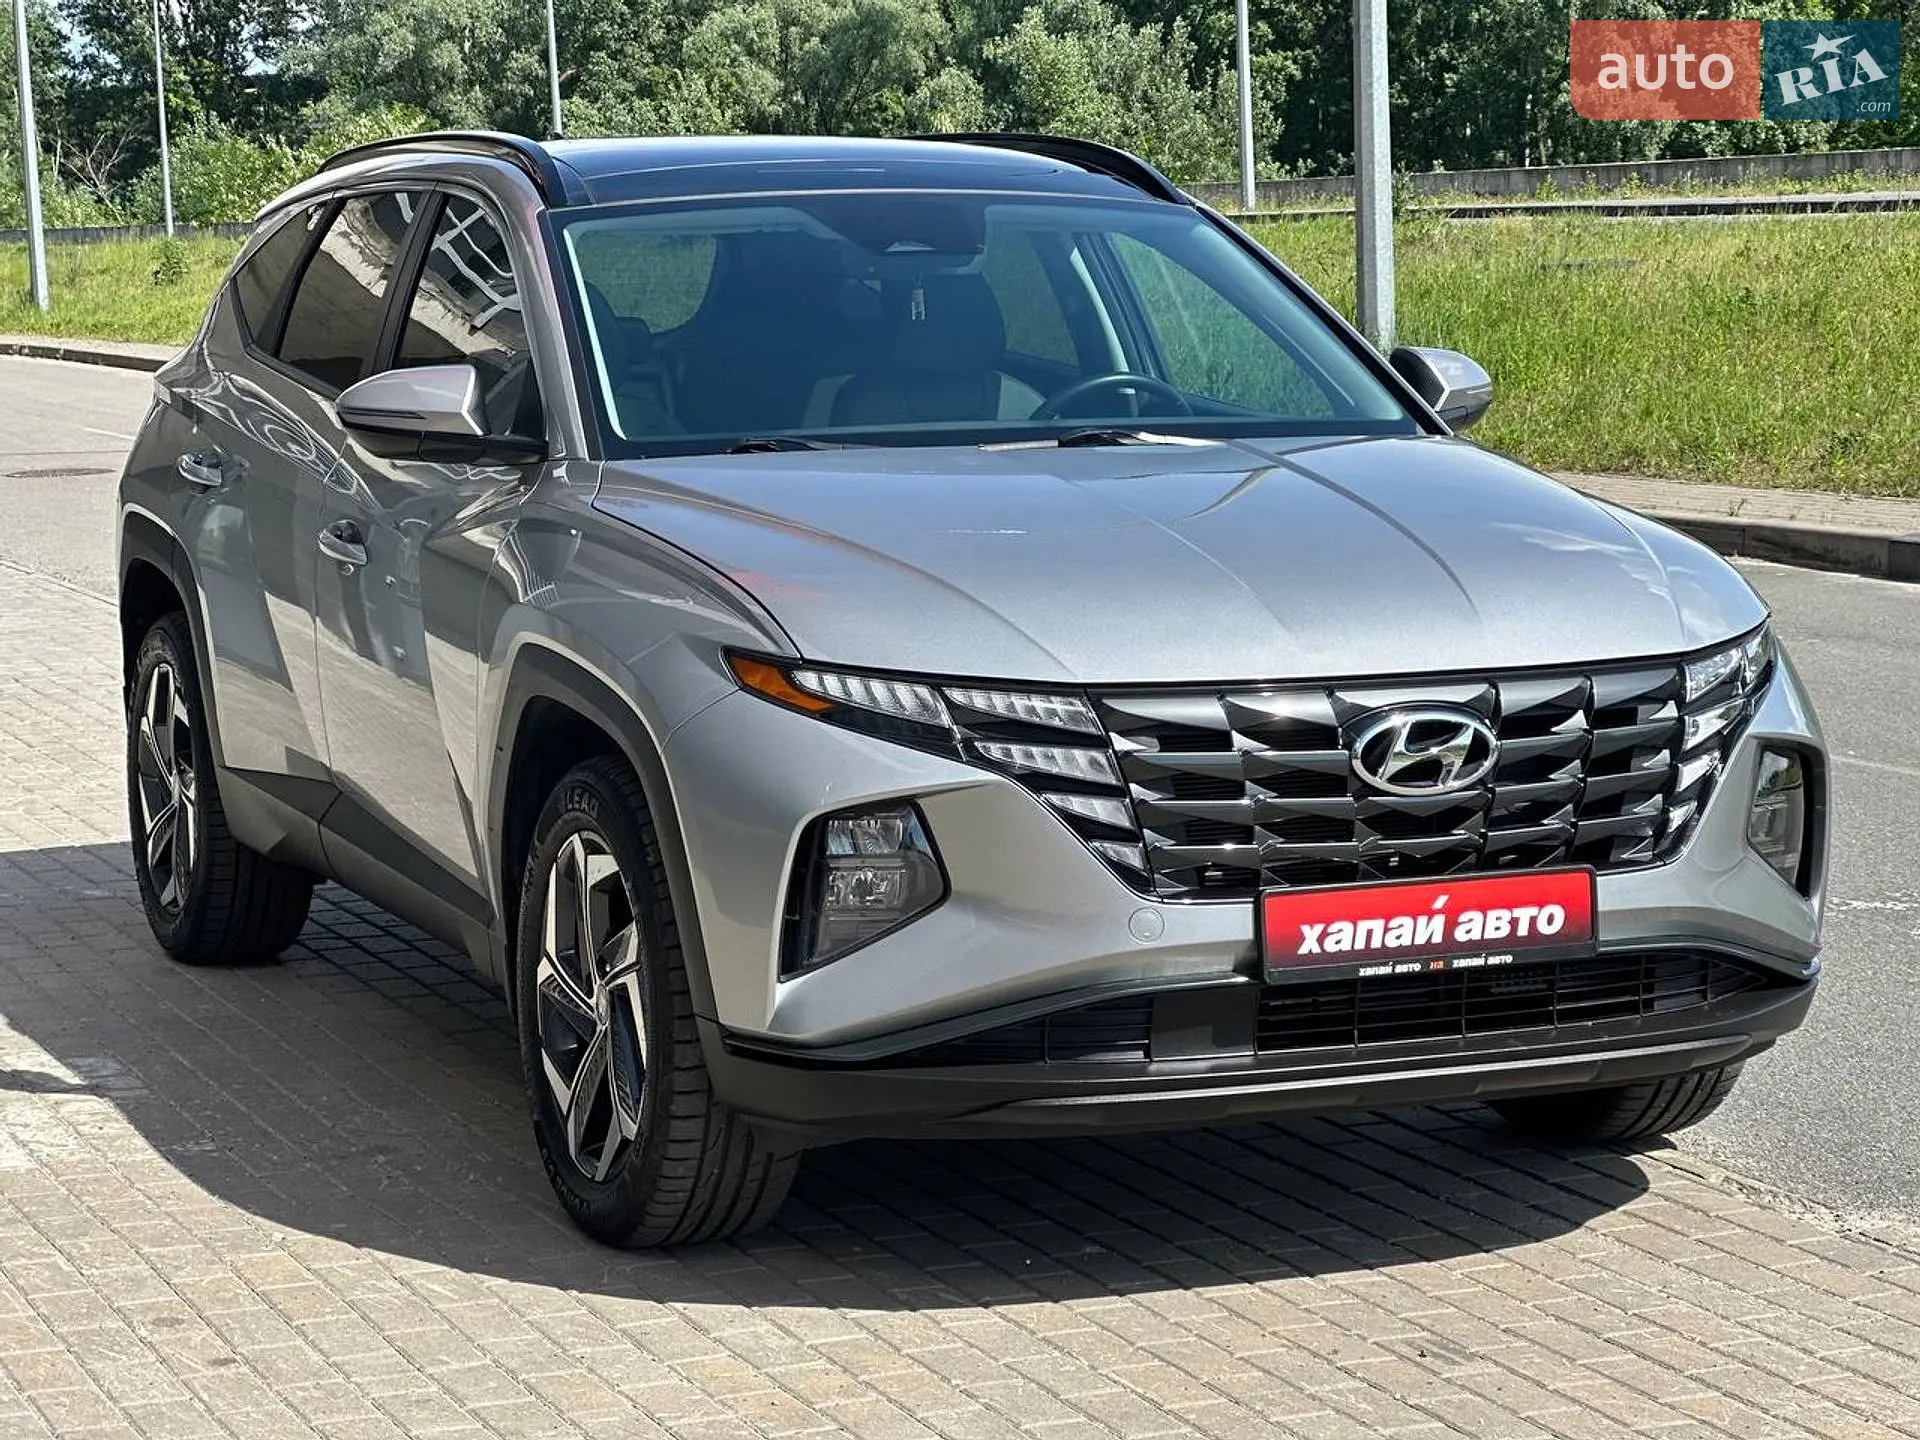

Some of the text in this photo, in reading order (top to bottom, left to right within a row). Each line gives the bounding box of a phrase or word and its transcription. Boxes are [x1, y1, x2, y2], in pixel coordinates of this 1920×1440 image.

[1297, 894, 1565, 955] хапай авто
[1394, 962, 1422, 973] авто
[1487, 954, 1513, 965] авто
